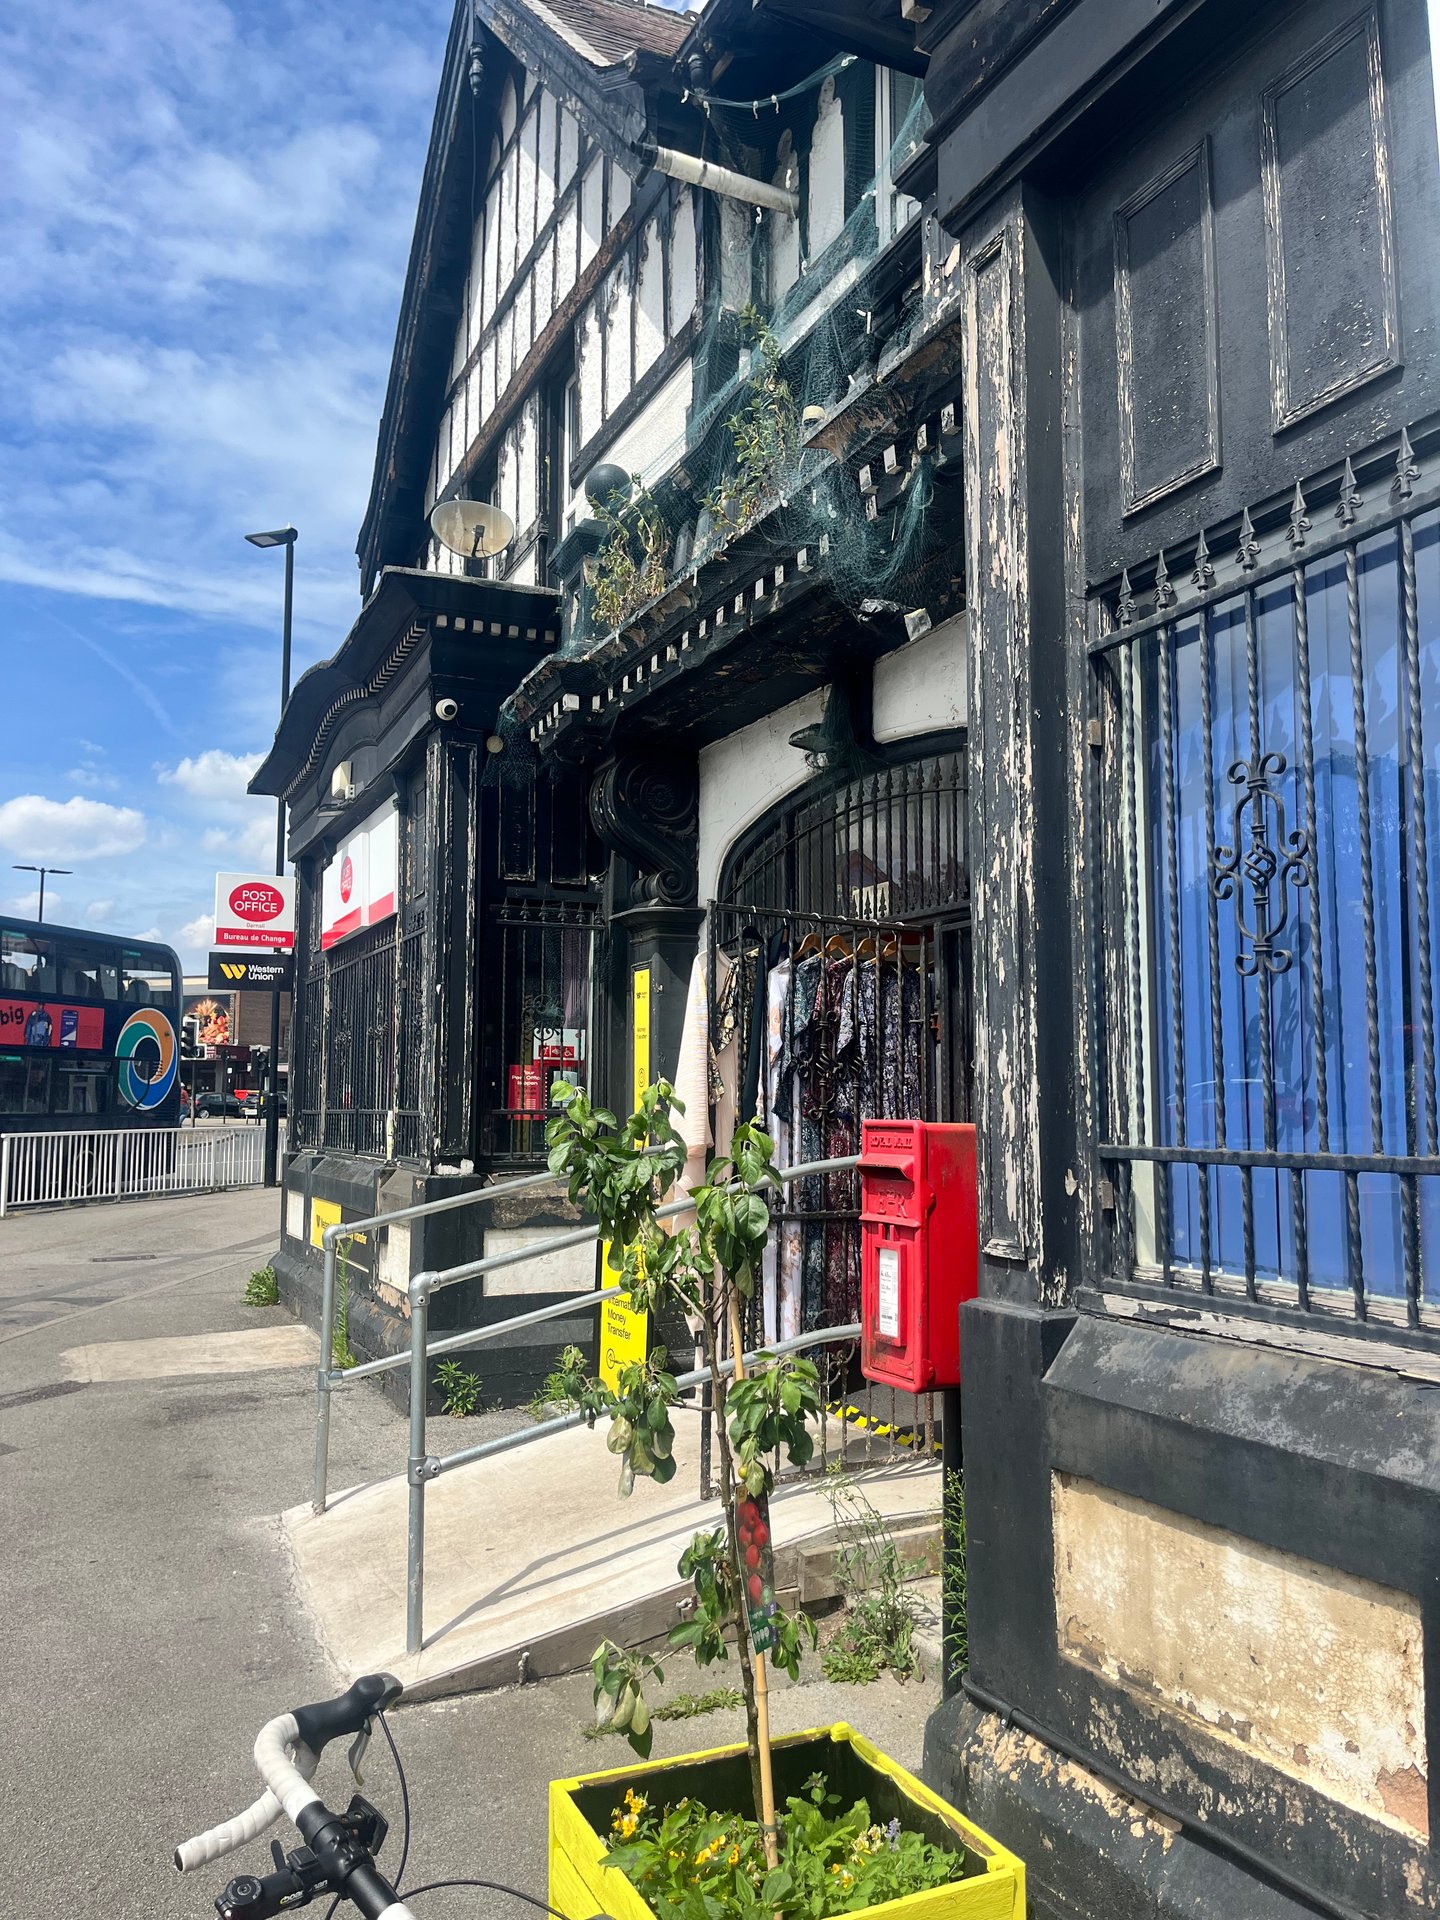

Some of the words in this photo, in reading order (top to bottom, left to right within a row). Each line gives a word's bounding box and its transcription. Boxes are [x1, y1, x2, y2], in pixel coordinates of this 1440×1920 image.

[242, 890, 274, 901] POST
[234, 901, 278, 913] OFFICE
[224, 933, 249, 941] Bureau
[261, 935, 286, 943] Change
[248, 964, 284, 973] Western
[248, 972, 274, 981] Union
[0, 1005, 24, 1025] big
[608, 1308, 626, 1325] Money
[607, 1322, 631, 1340] Transfer
